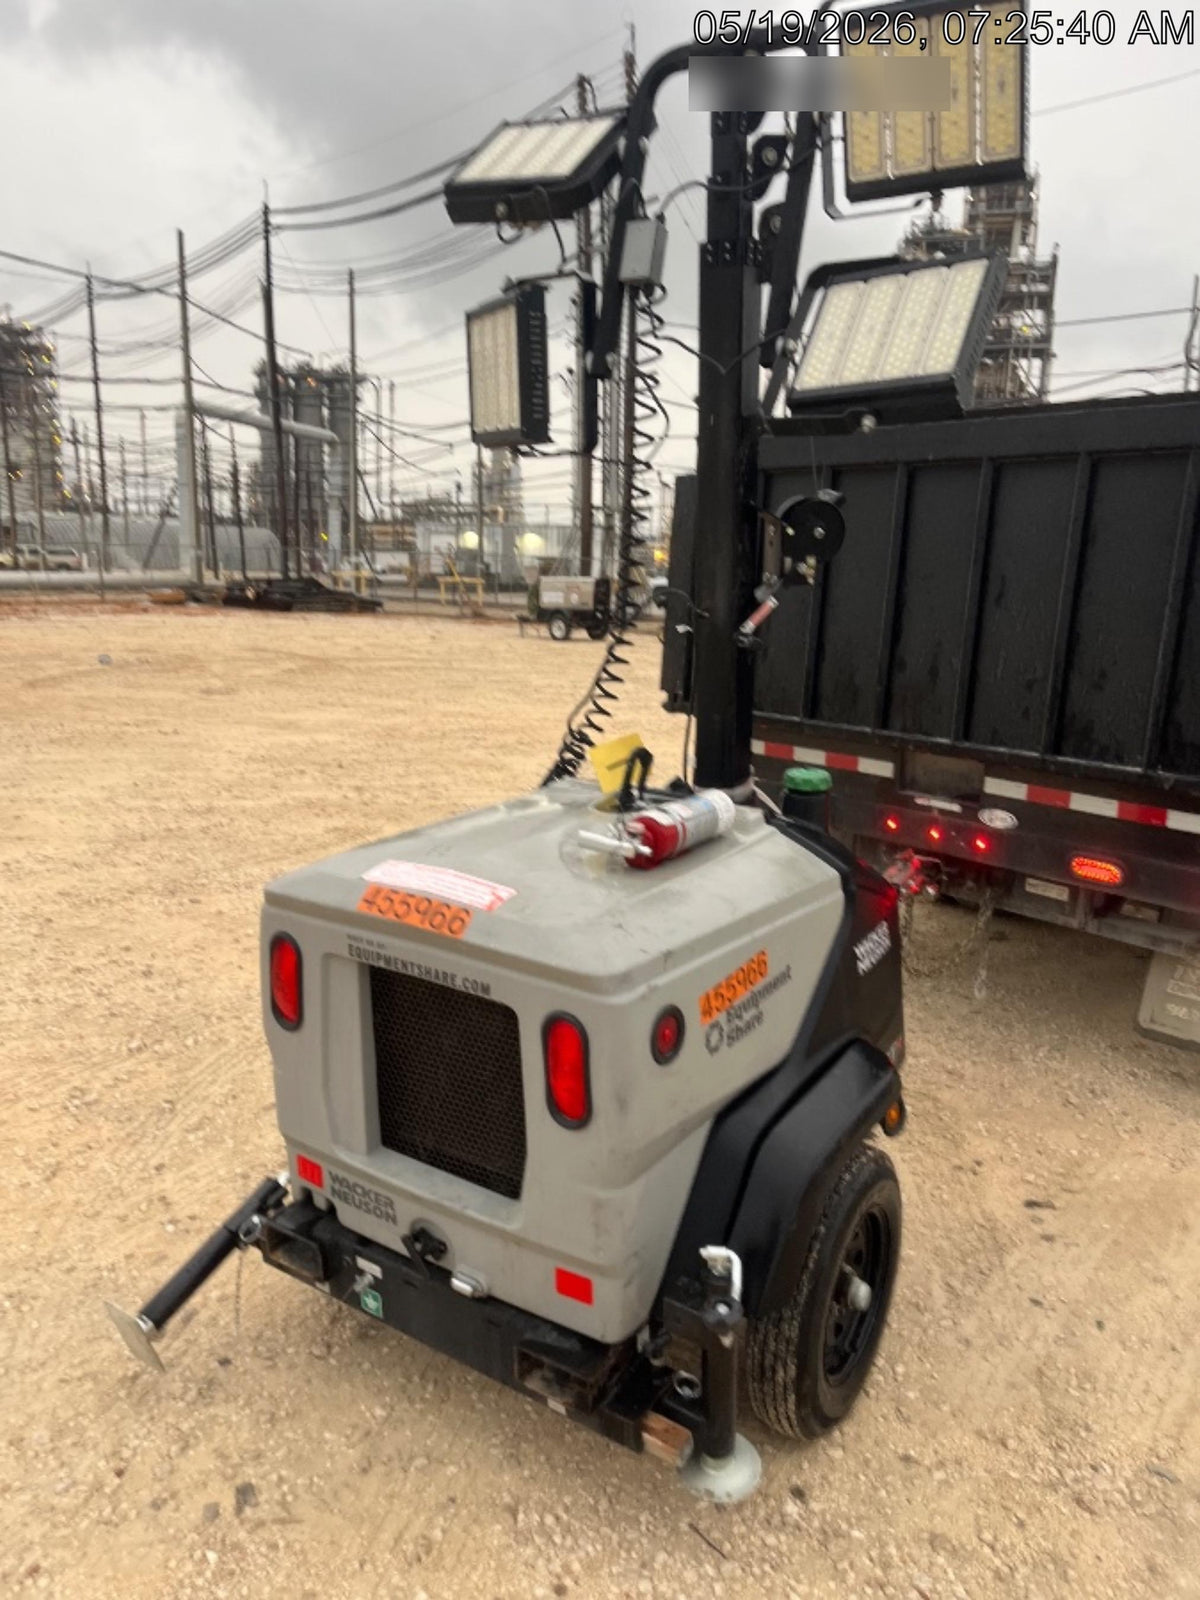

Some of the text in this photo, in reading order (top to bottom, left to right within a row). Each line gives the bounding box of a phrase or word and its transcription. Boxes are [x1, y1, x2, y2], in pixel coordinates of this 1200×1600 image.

[362, 886, 470, 936] 455966
[347, 943, 492, 997] EQUIPMENTSHARE.COM
[701, 950, 768, 1021] 455966
[726, 963, 792, 1025] Equipment
[726, 1011, 764, 1048] Share
[328, 1170, 395, 1210] WACKER
[330, 1185, 398, 1226] NEUSON
